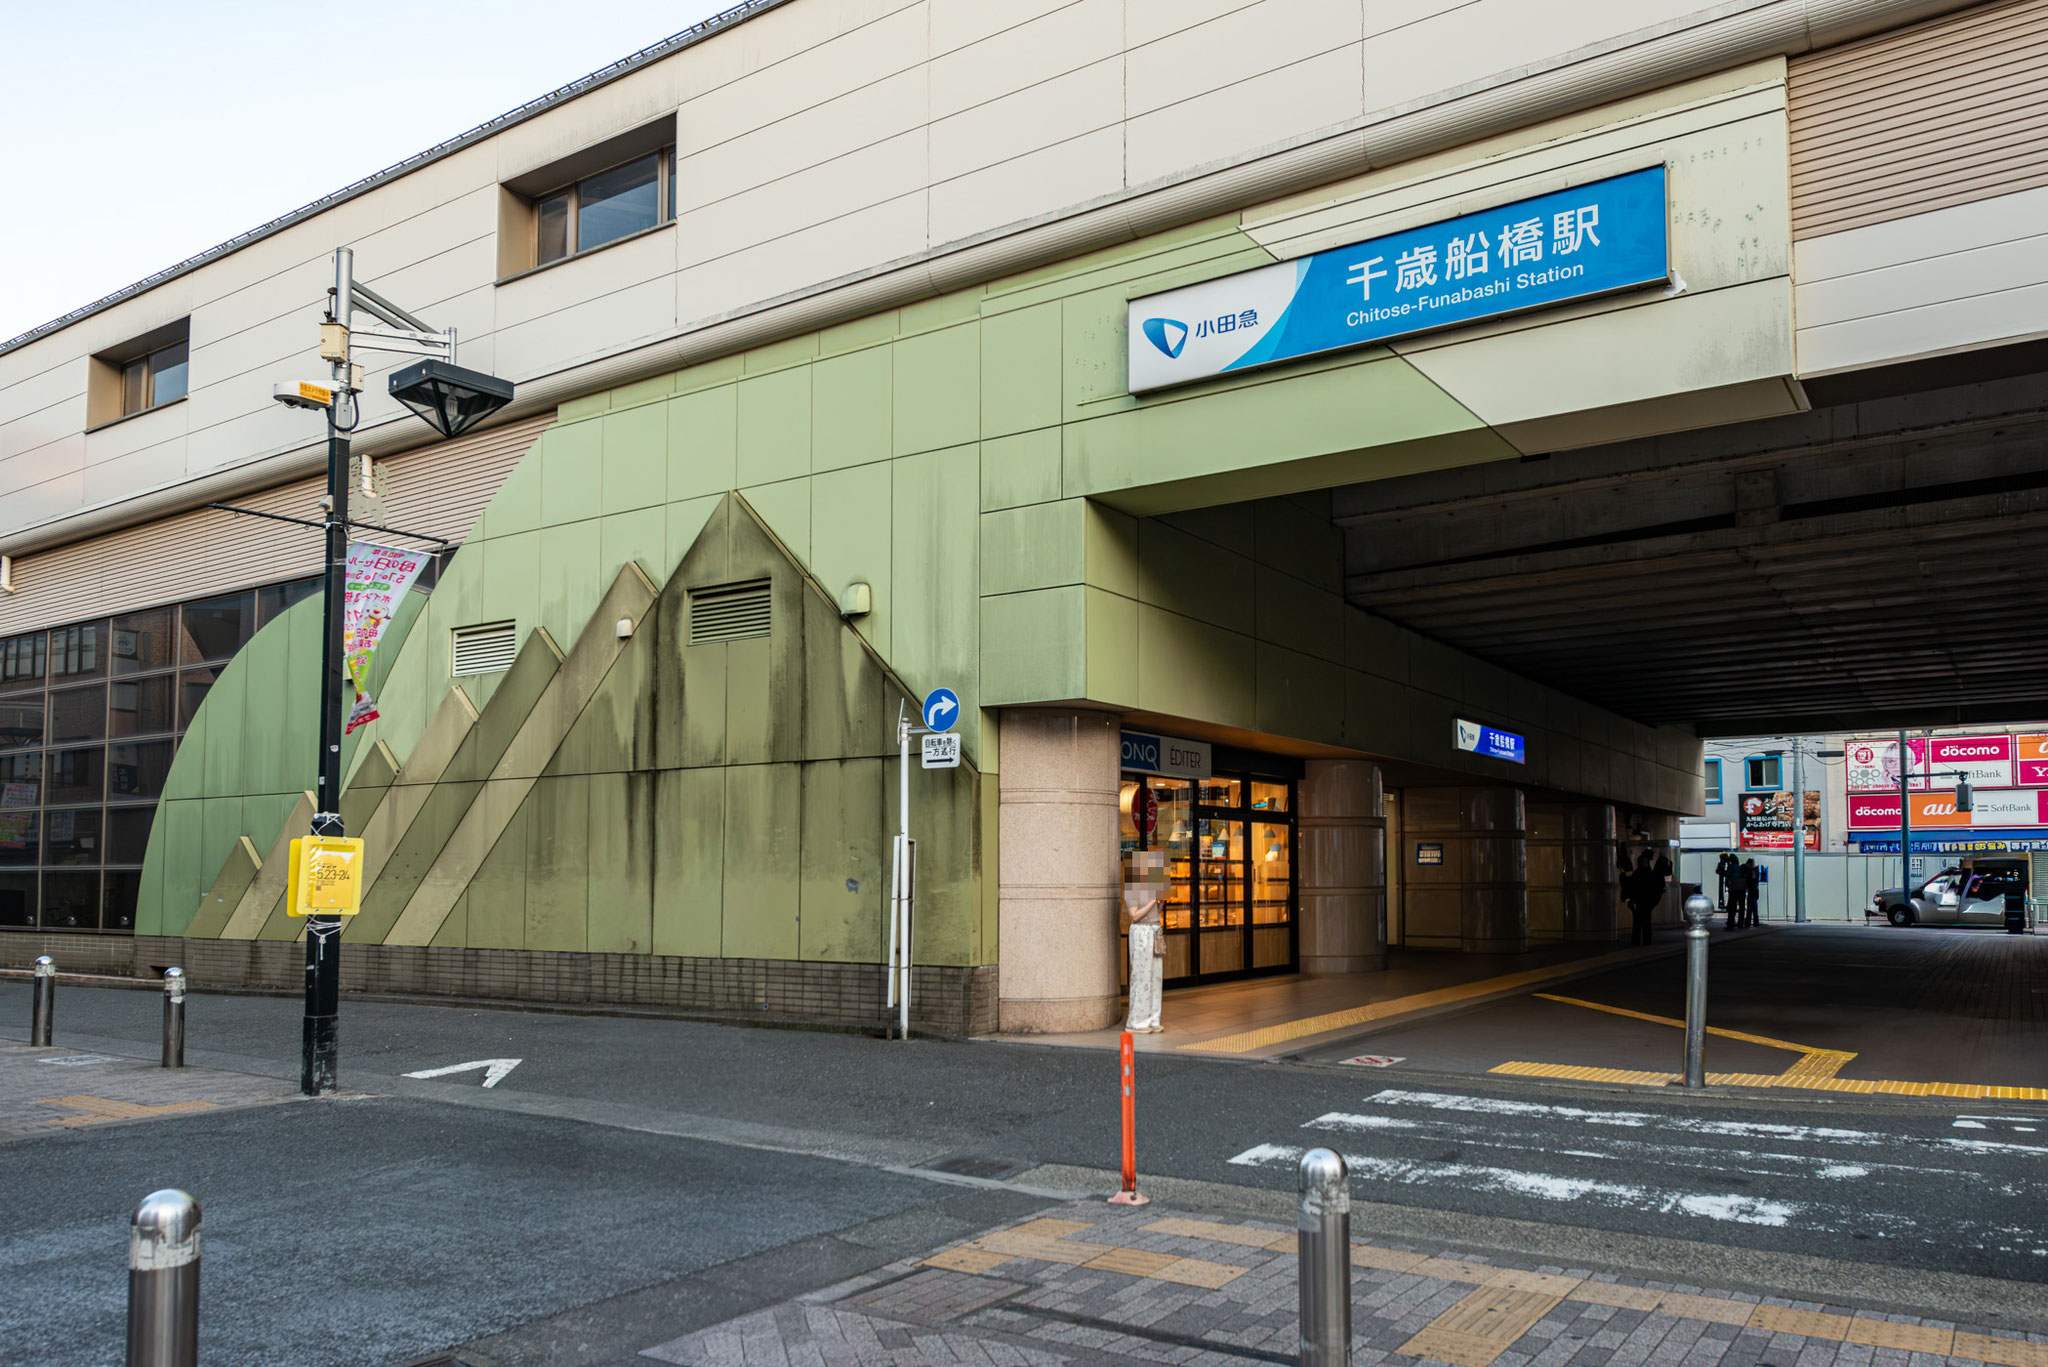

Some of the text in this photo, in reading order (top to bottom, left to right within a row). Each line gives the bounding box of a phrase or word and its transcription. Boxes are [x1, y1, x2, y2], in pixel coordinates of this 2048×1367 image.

[1346, 203, 1601, 302] 千歳船橋駅
[1346, 263, 1584, 328] Chitose-Funabashi Station
[1195, 308, 1259, 339] 小田急
[925, 736, 956, 748] 自転車を除く
[925, 746, 956, 756] 一方通行
[1940, 745, 2000, 756] docomo
[1170, 745, 1201, 769] ÉDITER
[1957, 769, 2002, 779] ftBank
[1855, 806, 1902, 816] docomo
[1923, 803, 1956, 816] au
[1990, 803, 2032, 813] SoftBank
